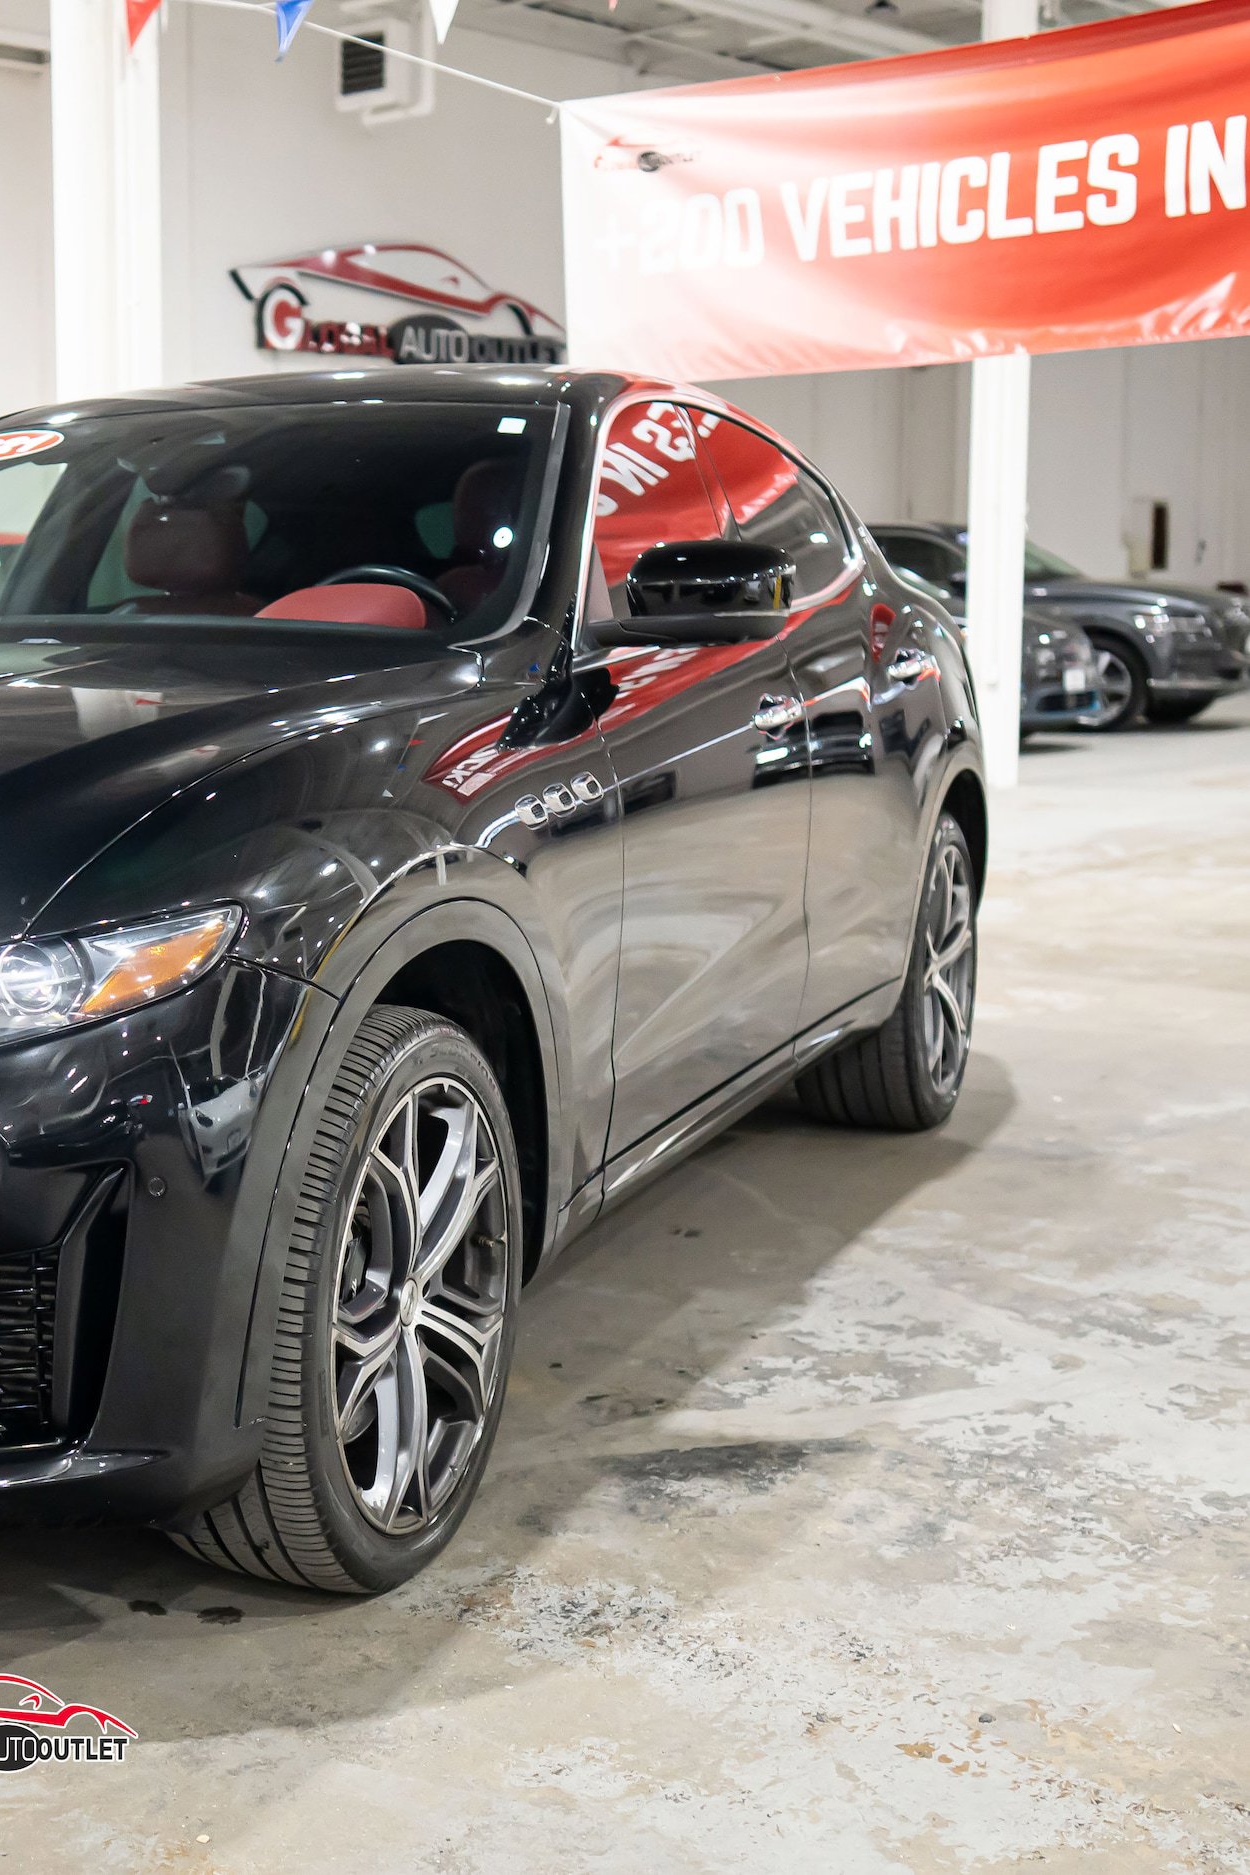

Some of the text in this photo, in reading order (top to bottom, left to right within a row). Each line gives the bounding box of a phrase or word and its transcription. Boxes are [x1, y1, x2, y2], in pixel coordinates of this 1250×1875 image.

[779, 133, 1139, 262] VEHICLES
[1165, 115, 1247, 218] IN
[399, 326, 469, 363] AUTO
